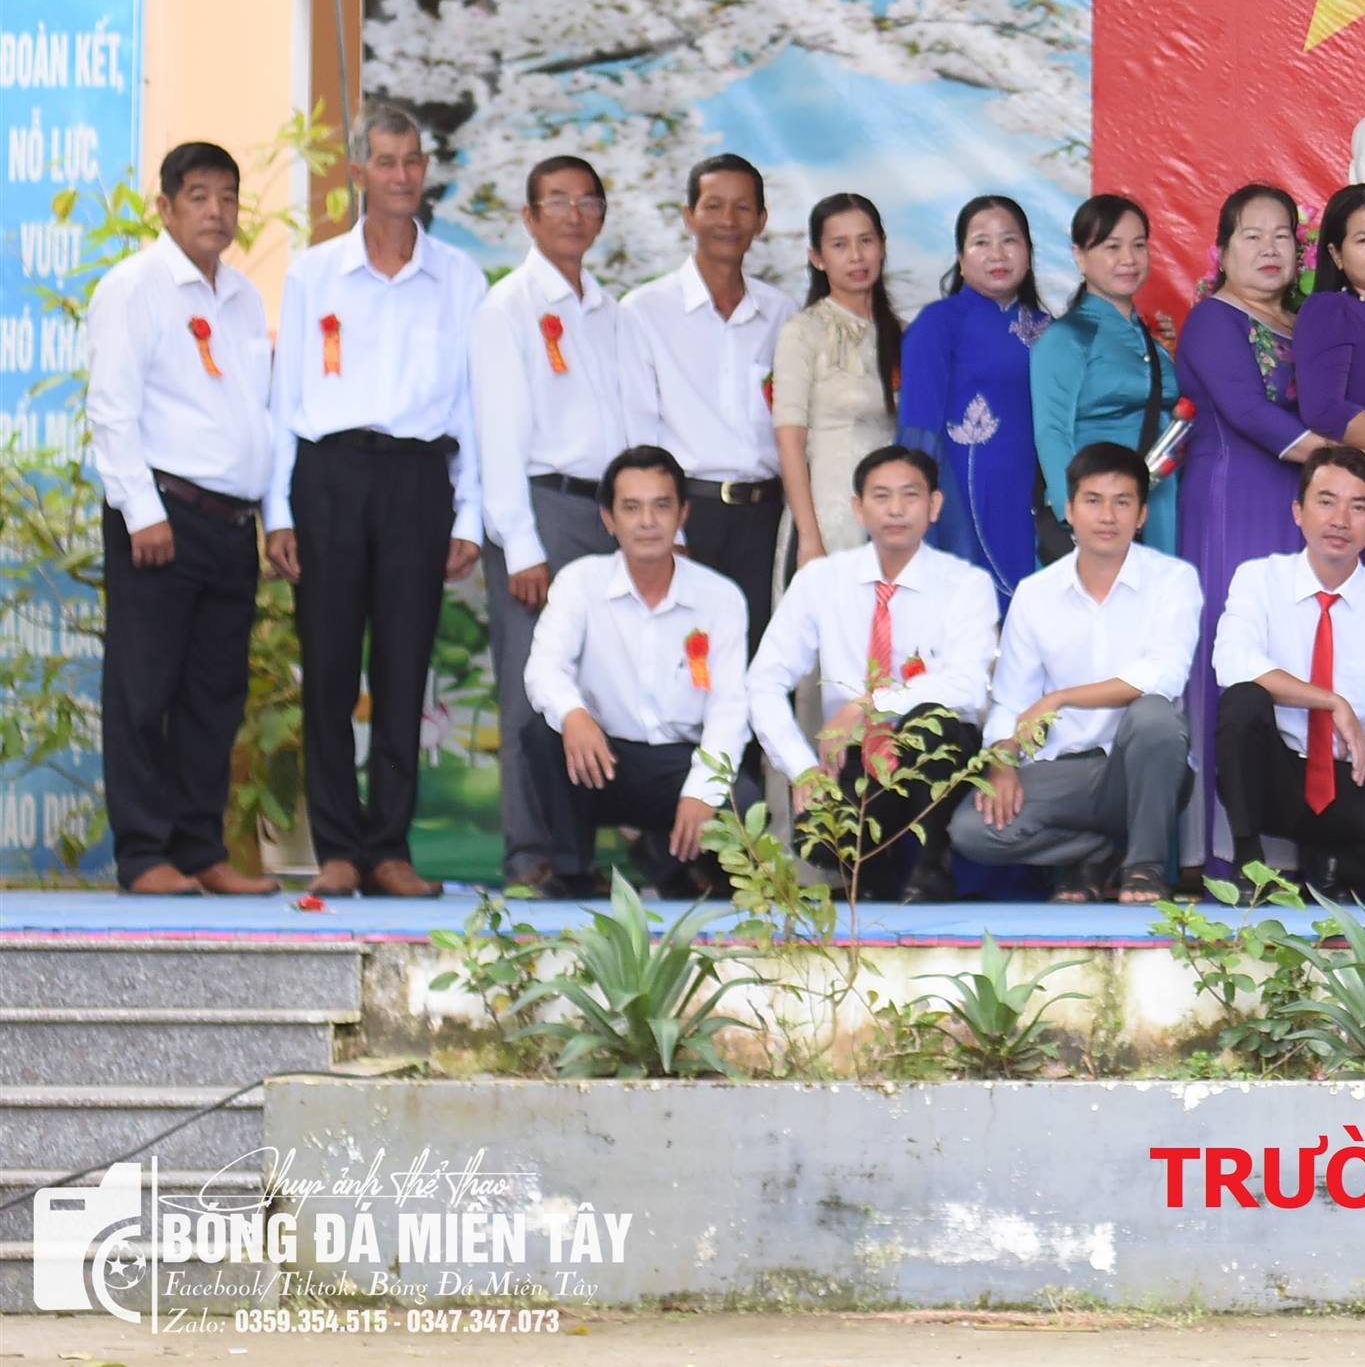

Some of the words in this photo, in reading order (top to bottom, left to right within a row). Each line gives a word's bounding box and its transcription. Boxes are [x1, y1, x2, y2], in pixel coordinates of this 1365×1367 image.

[75, 14, 124, 95] KẾT,
[8, 106, 45, 183] NỖ
[50, 120, 99, 191] LỰC
[20, 216, 84, 291] VƯỢT
